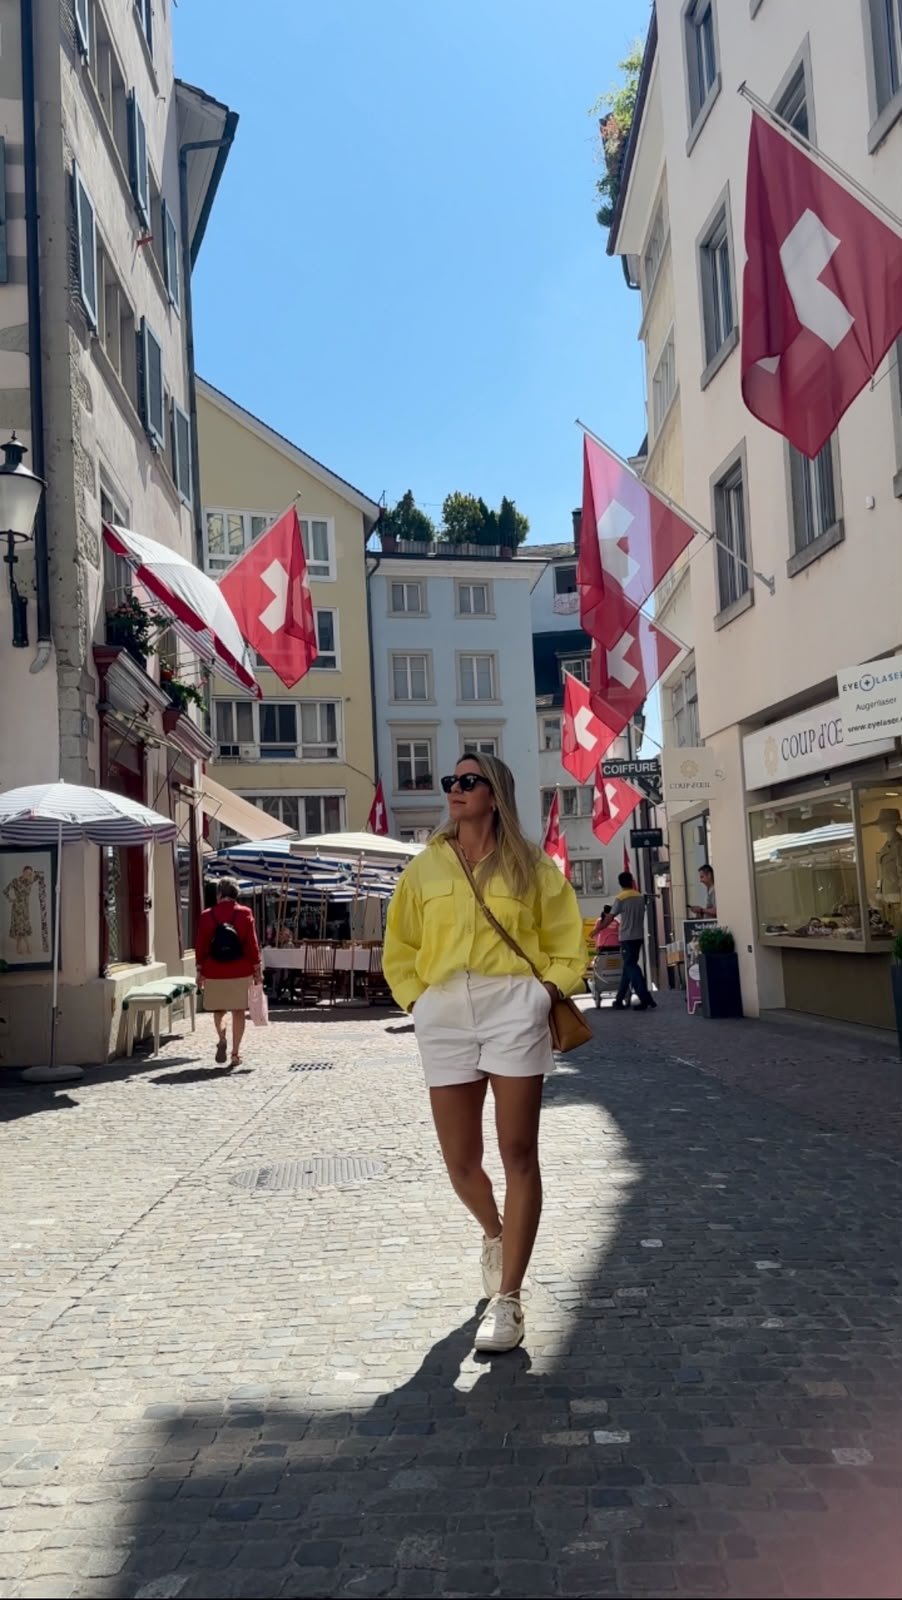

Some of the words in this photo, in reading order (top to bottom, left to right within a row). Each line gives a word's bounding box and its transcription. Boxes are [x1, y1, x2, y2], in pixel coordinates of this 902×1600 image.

[842, 682, 859, 692] EYE
[781, 729, 816, 761] COUP
[818, 718, 844, 749] d'Œ
[603, 762, 657, 775] COIFFURE
